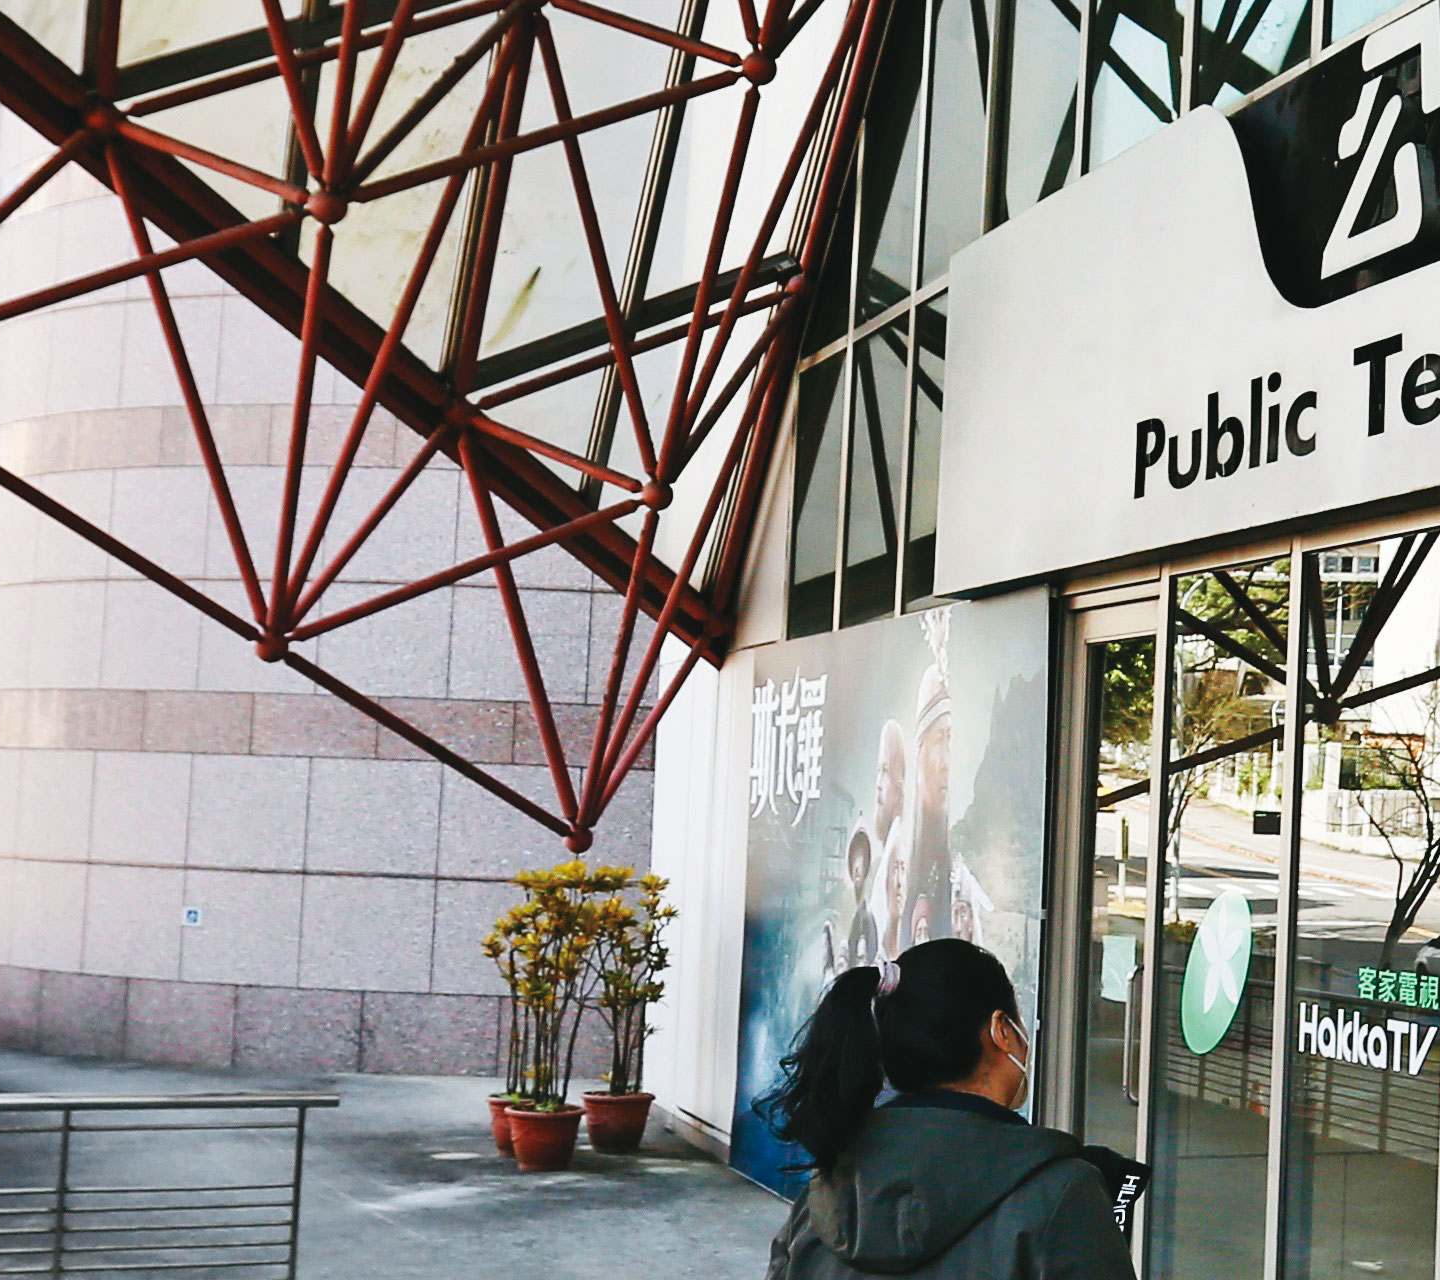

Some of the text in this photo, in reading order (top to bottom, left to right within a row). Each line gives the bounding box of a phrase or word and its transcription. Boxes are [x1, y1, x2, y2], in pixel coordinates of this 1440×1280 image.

[1133, 372, 1318, 500] Public
[1358, 967, 1439, 1010] 客家電視
[1299, 1002, 1438, 1075] HakkaTV
